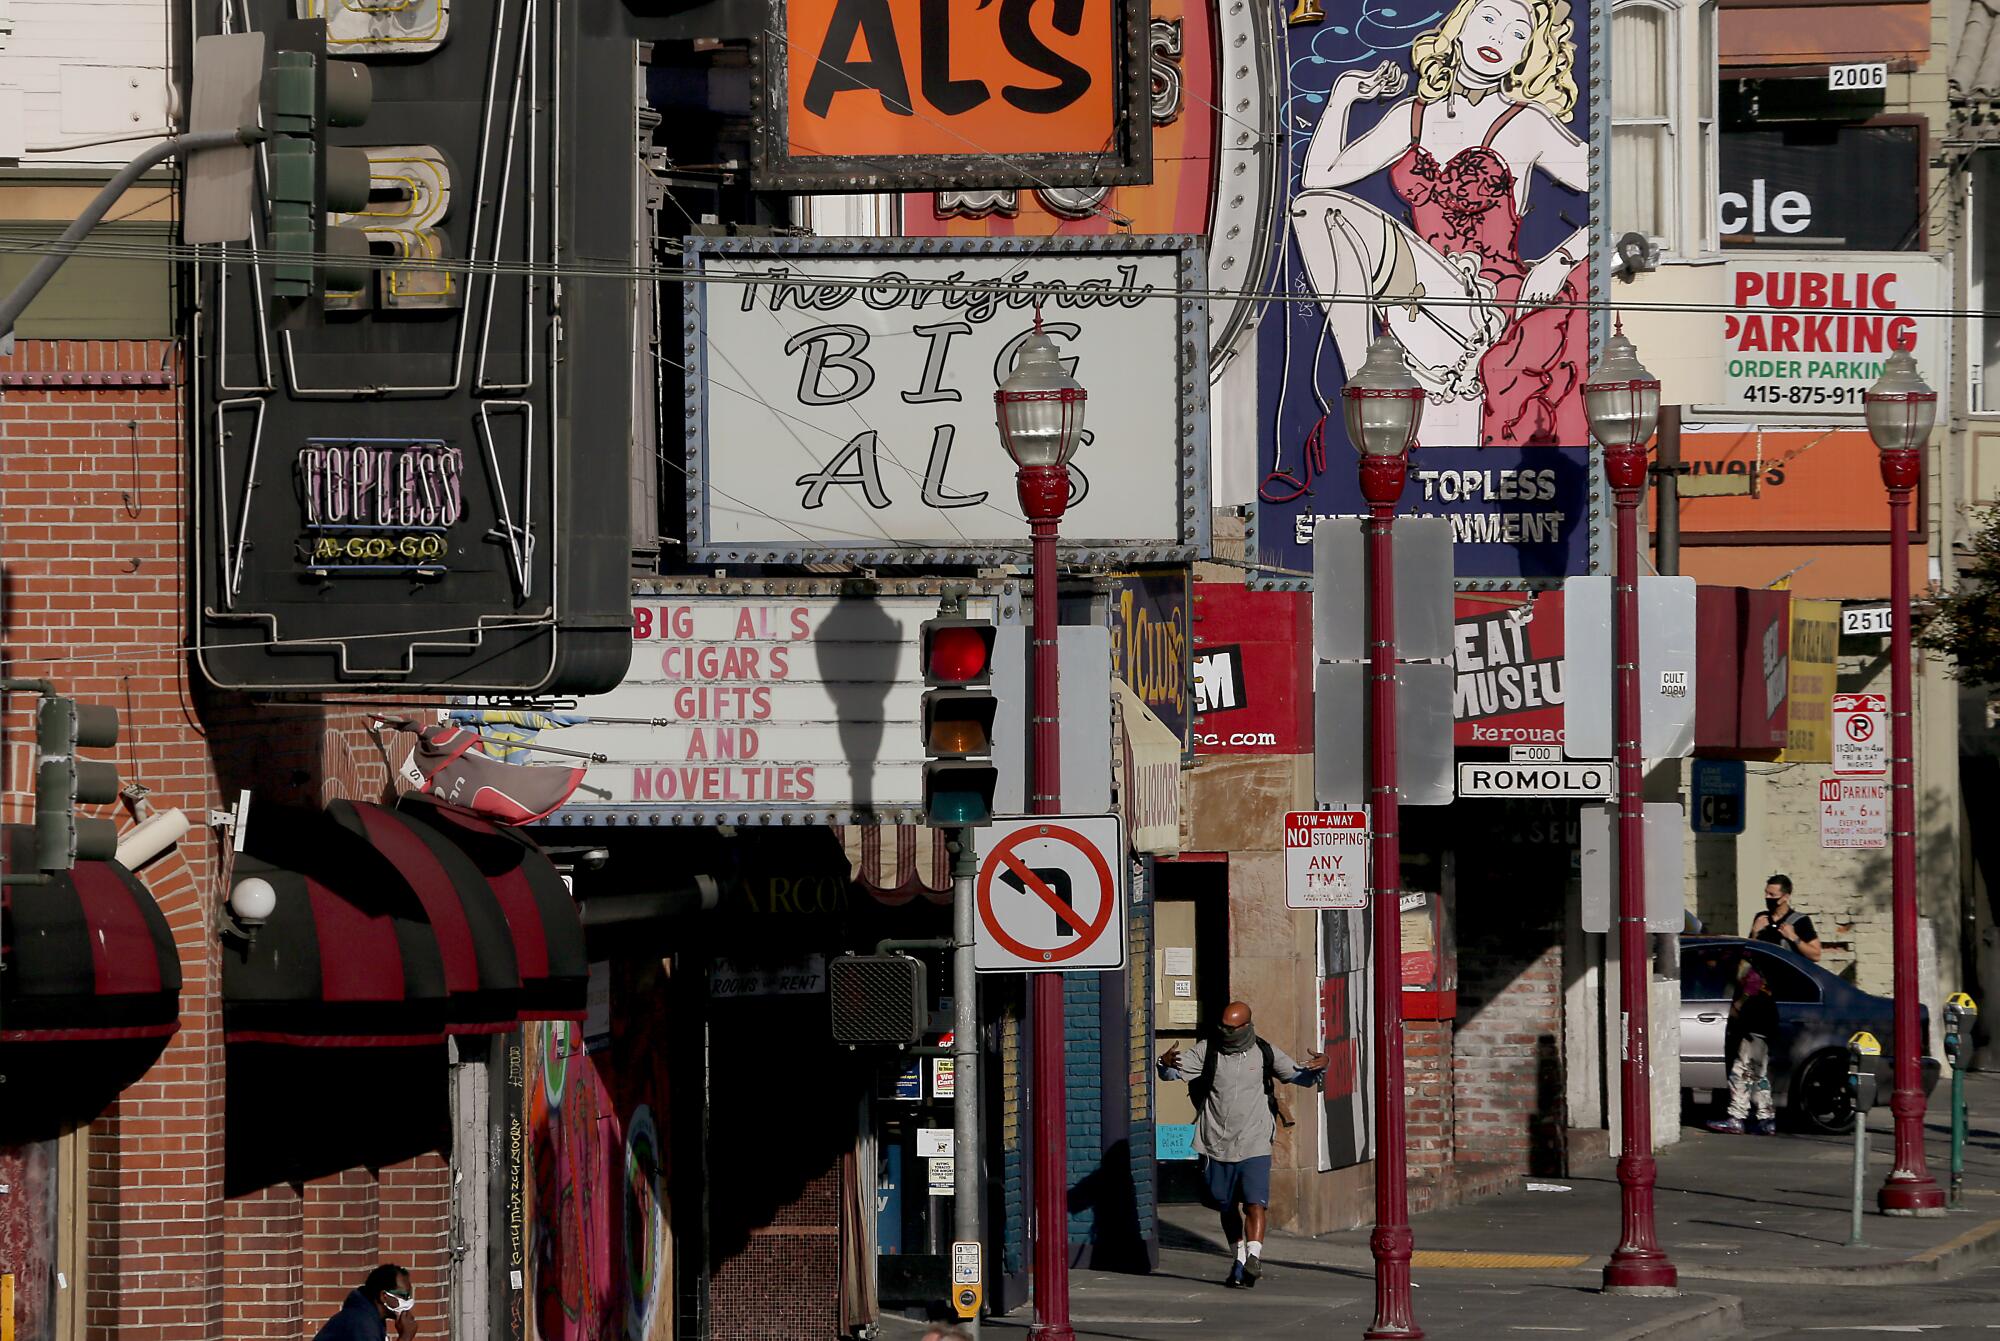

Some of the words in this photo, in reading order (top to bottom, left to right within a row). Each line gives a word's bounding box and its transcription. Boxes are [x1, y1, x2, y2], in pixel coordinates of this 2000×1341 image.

[1833, 66, 1883, 87] 2006
[739, 267, 858, 312] The
[861, 264, 1153, 322] Original
[1735, 271, 1897, 310] PUBLIC
[1728, 360, 1802, 378] ORDER
[1807, 361, 1887, 379] PARKIN
[1744, 385, 1867, 405] 415-875-911
[300, 445, 462, 527] TOPLESS
[1418, 469, 1556, 501] TOPLESS
[316, 535, 447, 559] A-GO-GO
[633, 606, 694, 639] BIG
[1454, 610, 1533, 672] EAT
[661, 646, 789, 680] CIGARS
[1454, 660, 1565, 719] MUSEU
[1663, 672, 1685, 684] CULT
[674, 686, 771, 720] GIFTS
[686, 727, 759, 760] AND
[1528, 748, 1551, 760] 000
[633, 767, 815, 800] NOVELTIES
[1473, 769, 1601, 790] ROMOLO
[1822, 782, 1839, 800] NO
[1842, 785, 1885, 799] PARKING
[1143, 762, 1178, 828] LIQUORS
[1296, 815, 1354, 826] TOW-AWAY
[1287, 828, 1309, 846] NO
[1313, 832, 1364, 846] STOPPING
[1309, 855, 1343, 870] ANY
[779, 974, 820, 991] RENT
